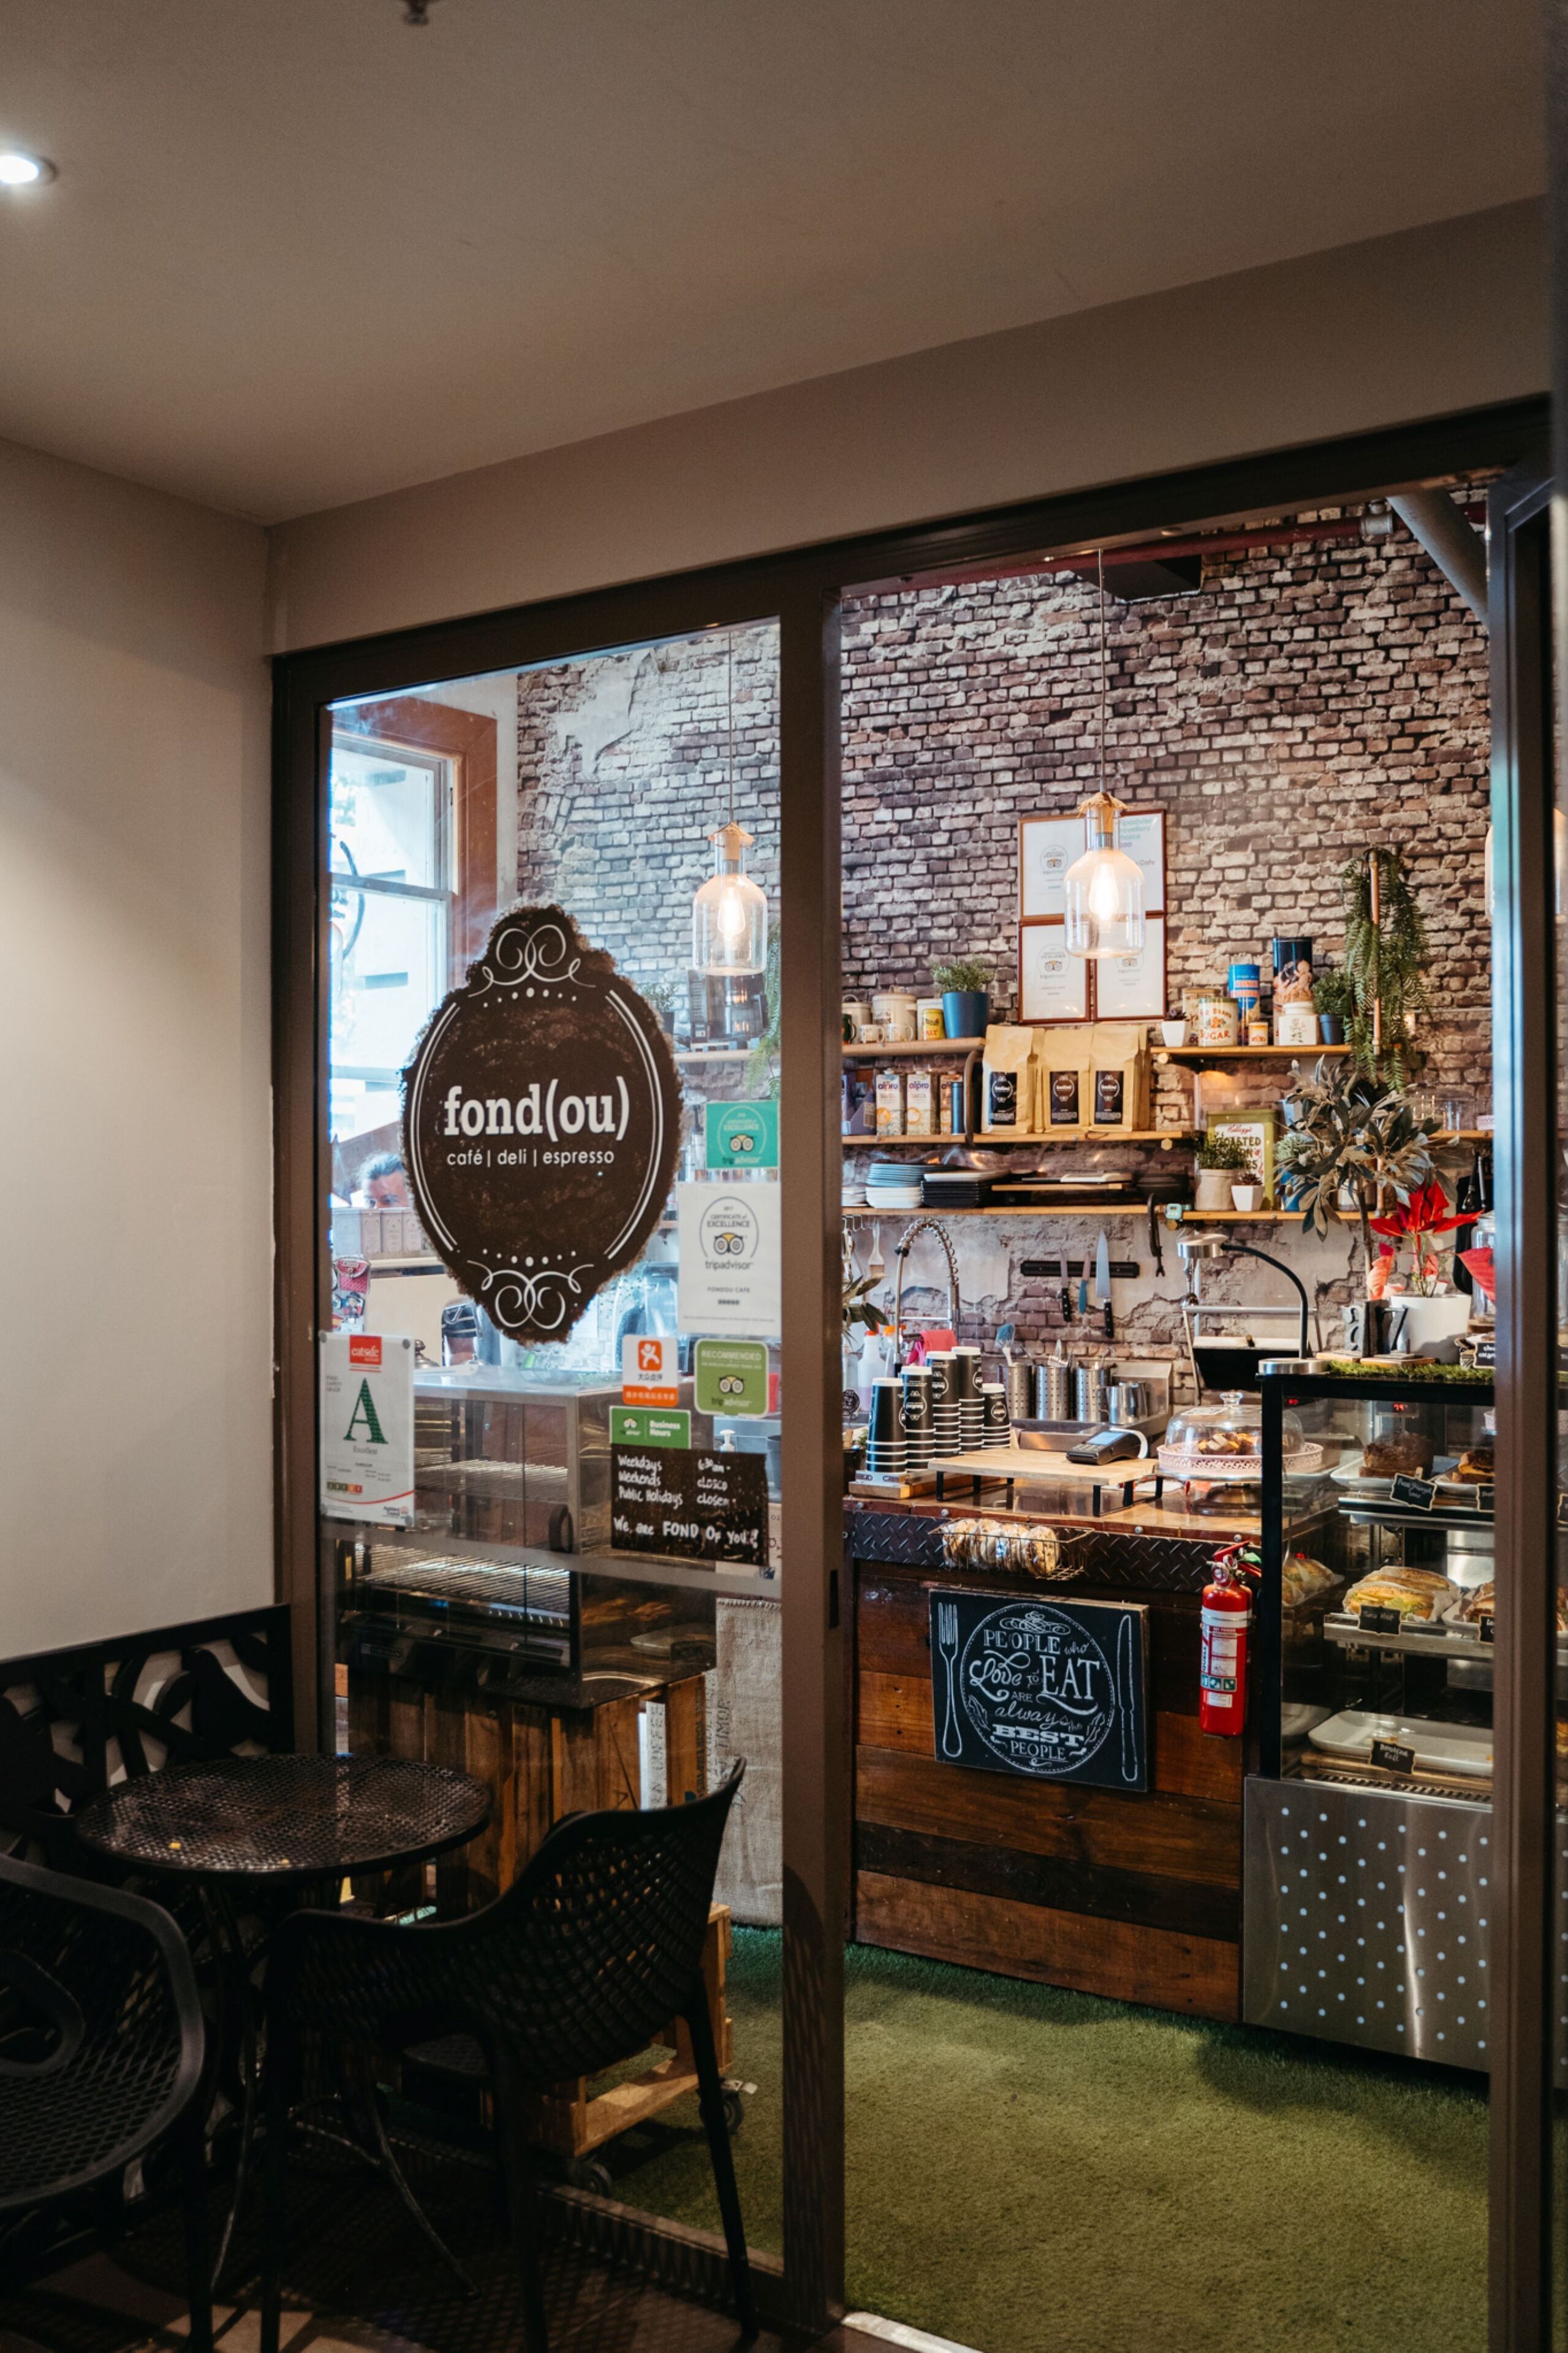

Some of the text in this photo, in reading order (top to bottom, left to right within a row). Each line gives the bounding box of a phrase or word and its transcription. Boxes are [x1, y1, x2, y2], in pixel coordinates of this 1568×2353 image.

[909, 1080, 930, 1091] alpro
[444, 1075, 630, 1142] fond(ou)
[447, 1149, 483, 1165] café
[497, 1148, 527, 1165] deli
[542, 1150, 615, 1168] espresso
[705, 1260, 751, 1271] tripadvisor
[701, 1349, 762, 1361] RECOMMENDED
[343, 1377, 389, 1445] A
[650, 1420, 681, 1430] Business
[650, 1428, 672, 1438] Hours
[618, 1454, 663, 1472] Weekdays
[662, 1520, 699, 1539] FOND
[983, 1629, 1061, 1654] PEOPLE
[1035, 1654, 1100, 1716] EAT
[1010, 1691, 1034, 1703] ARE
[994, 1701, 1070, 1730] always
[991, 1723, 1085, 1748] BEST
[1010, 1740, 1067, 1760] PEOPLE
